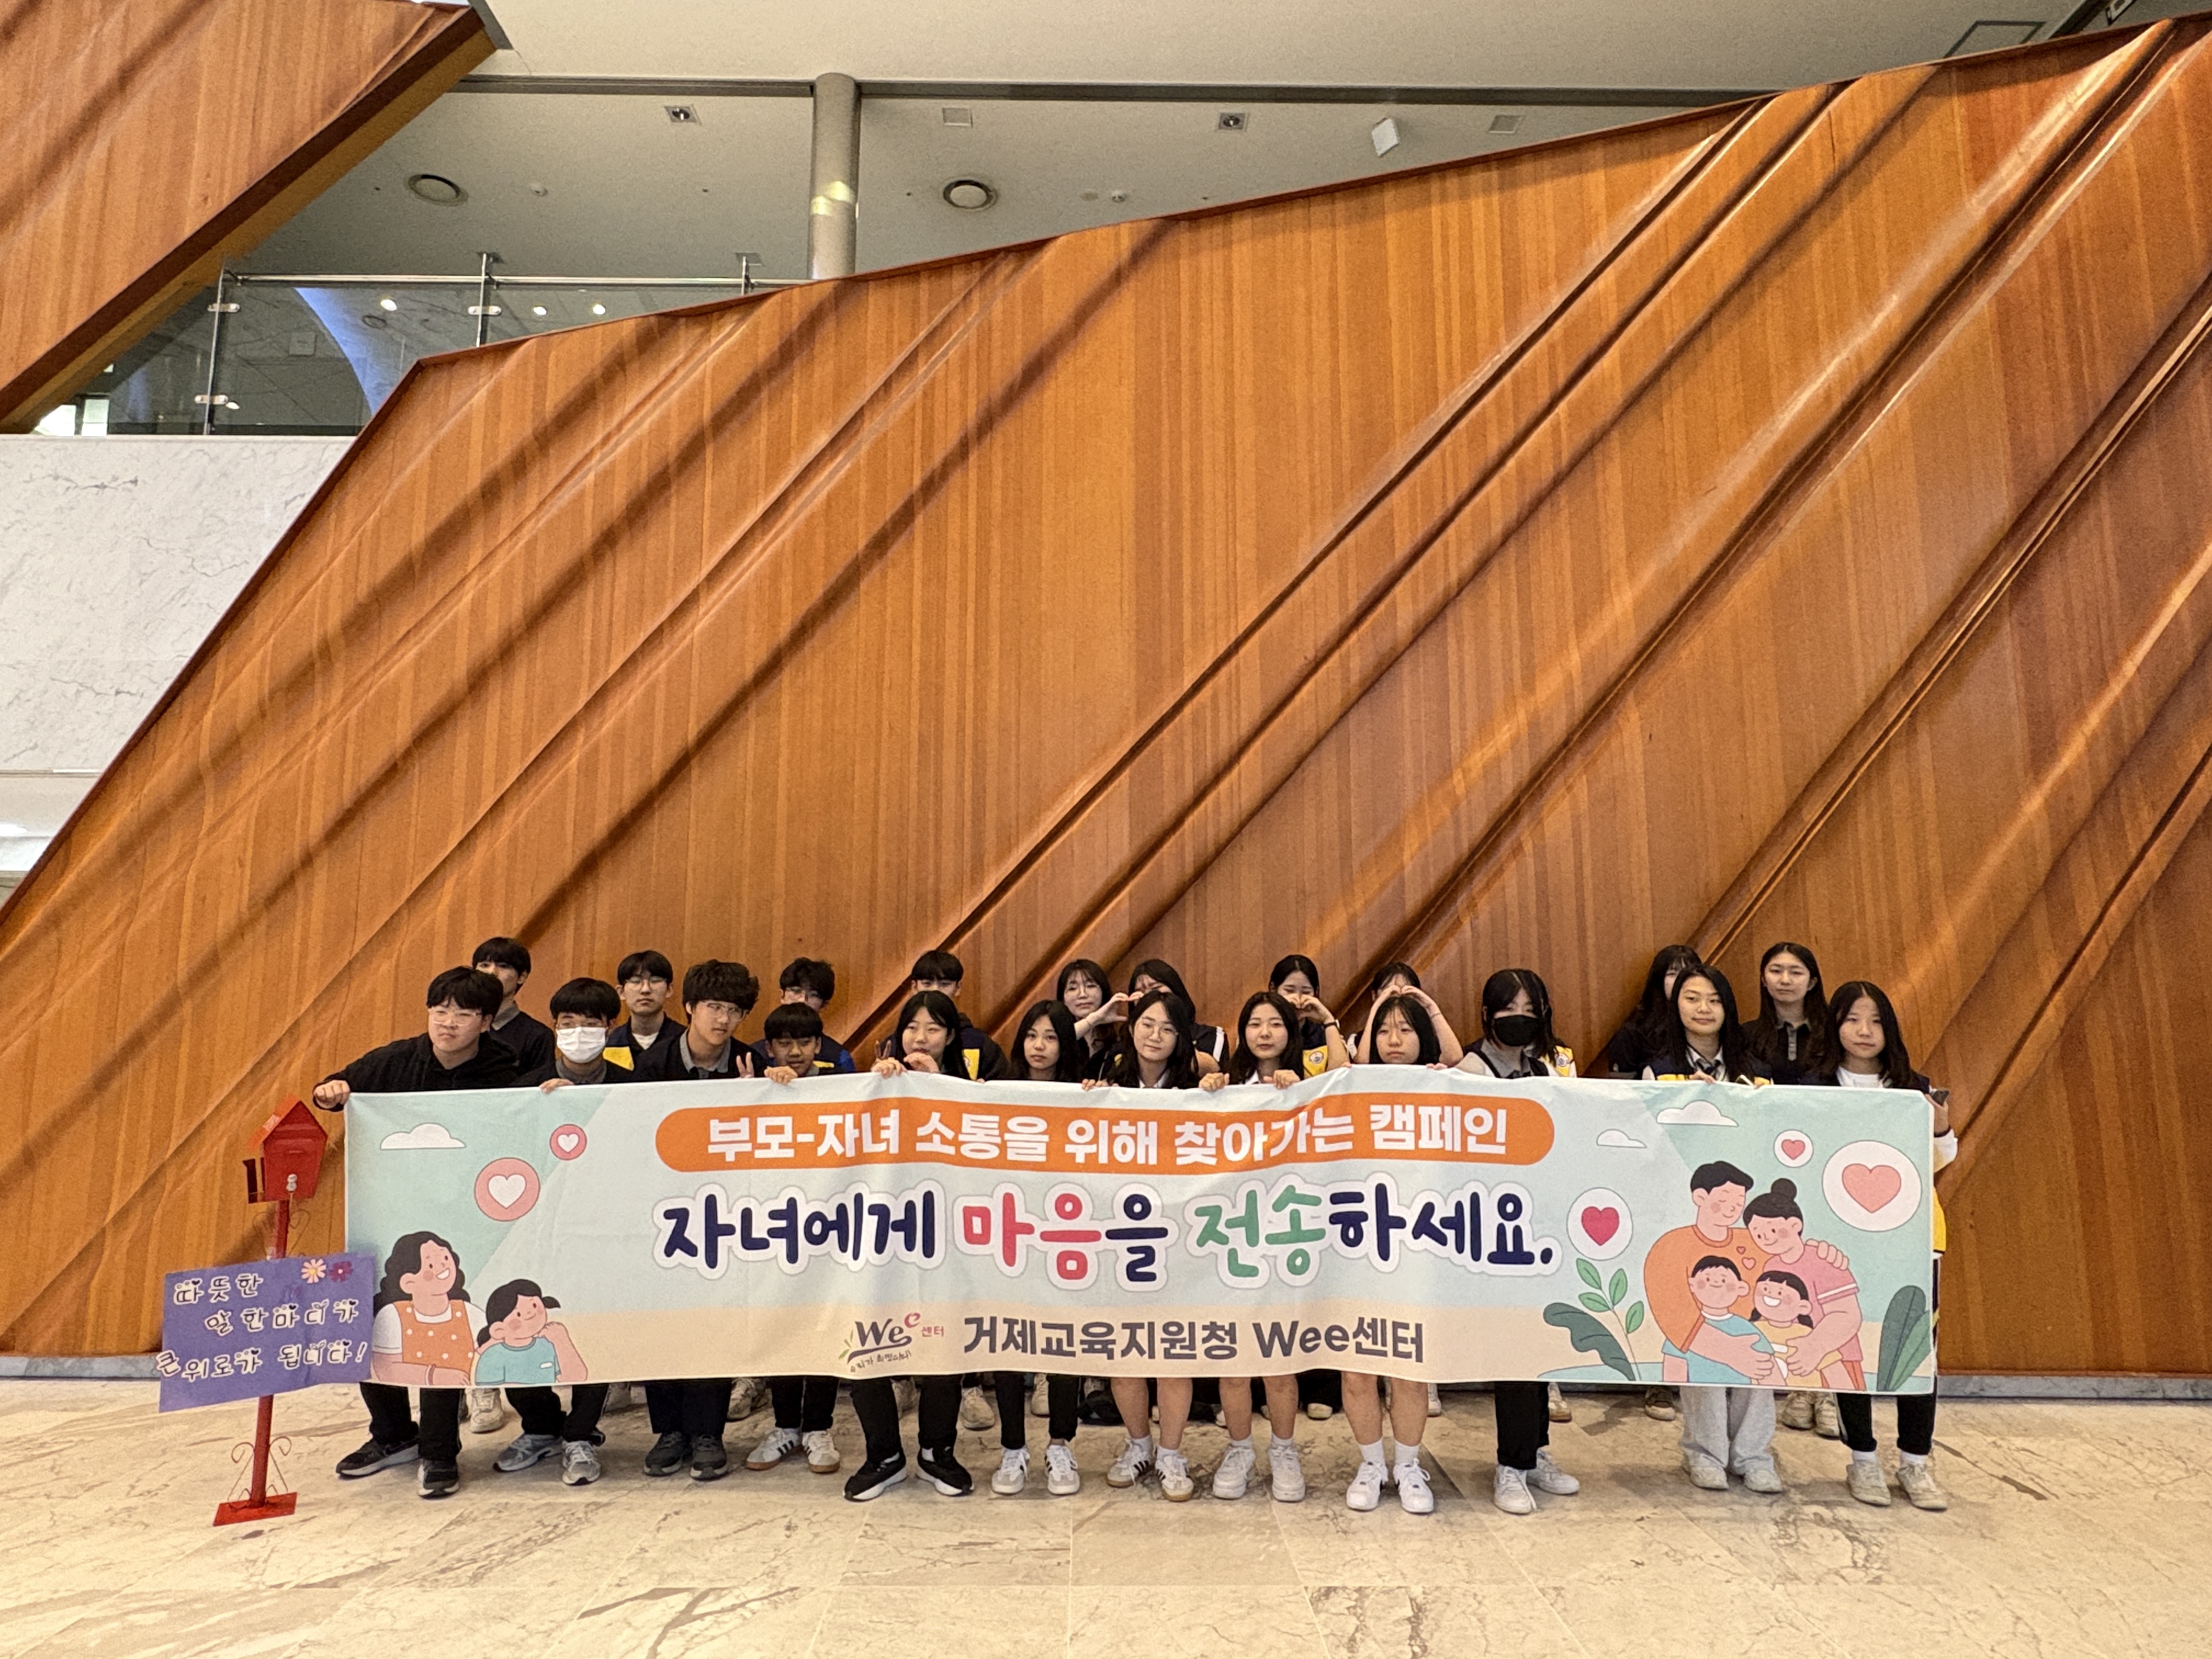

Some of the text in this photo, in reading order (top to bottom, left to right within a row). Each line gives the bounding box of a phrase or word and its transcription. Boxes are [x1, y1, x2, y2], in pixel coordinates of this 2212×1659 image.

[708, 1104, 1506, 1165] 부모-자녀 소통을 위해 찾아가는 캠페인
[663, 1183, 1554, 1283] 자녀에게 마음을 전송하세요.
[173, 1273, 262, 1305] 따뜻한
[206, 1300, 358, 1336] 말 한마디가
[922, 1325, 944, 1337] 센터
[278, 1340, 367, 1370] 됩니다!
[963, 1317, 1424, 1363] 거제교육지원청 Wee센터
